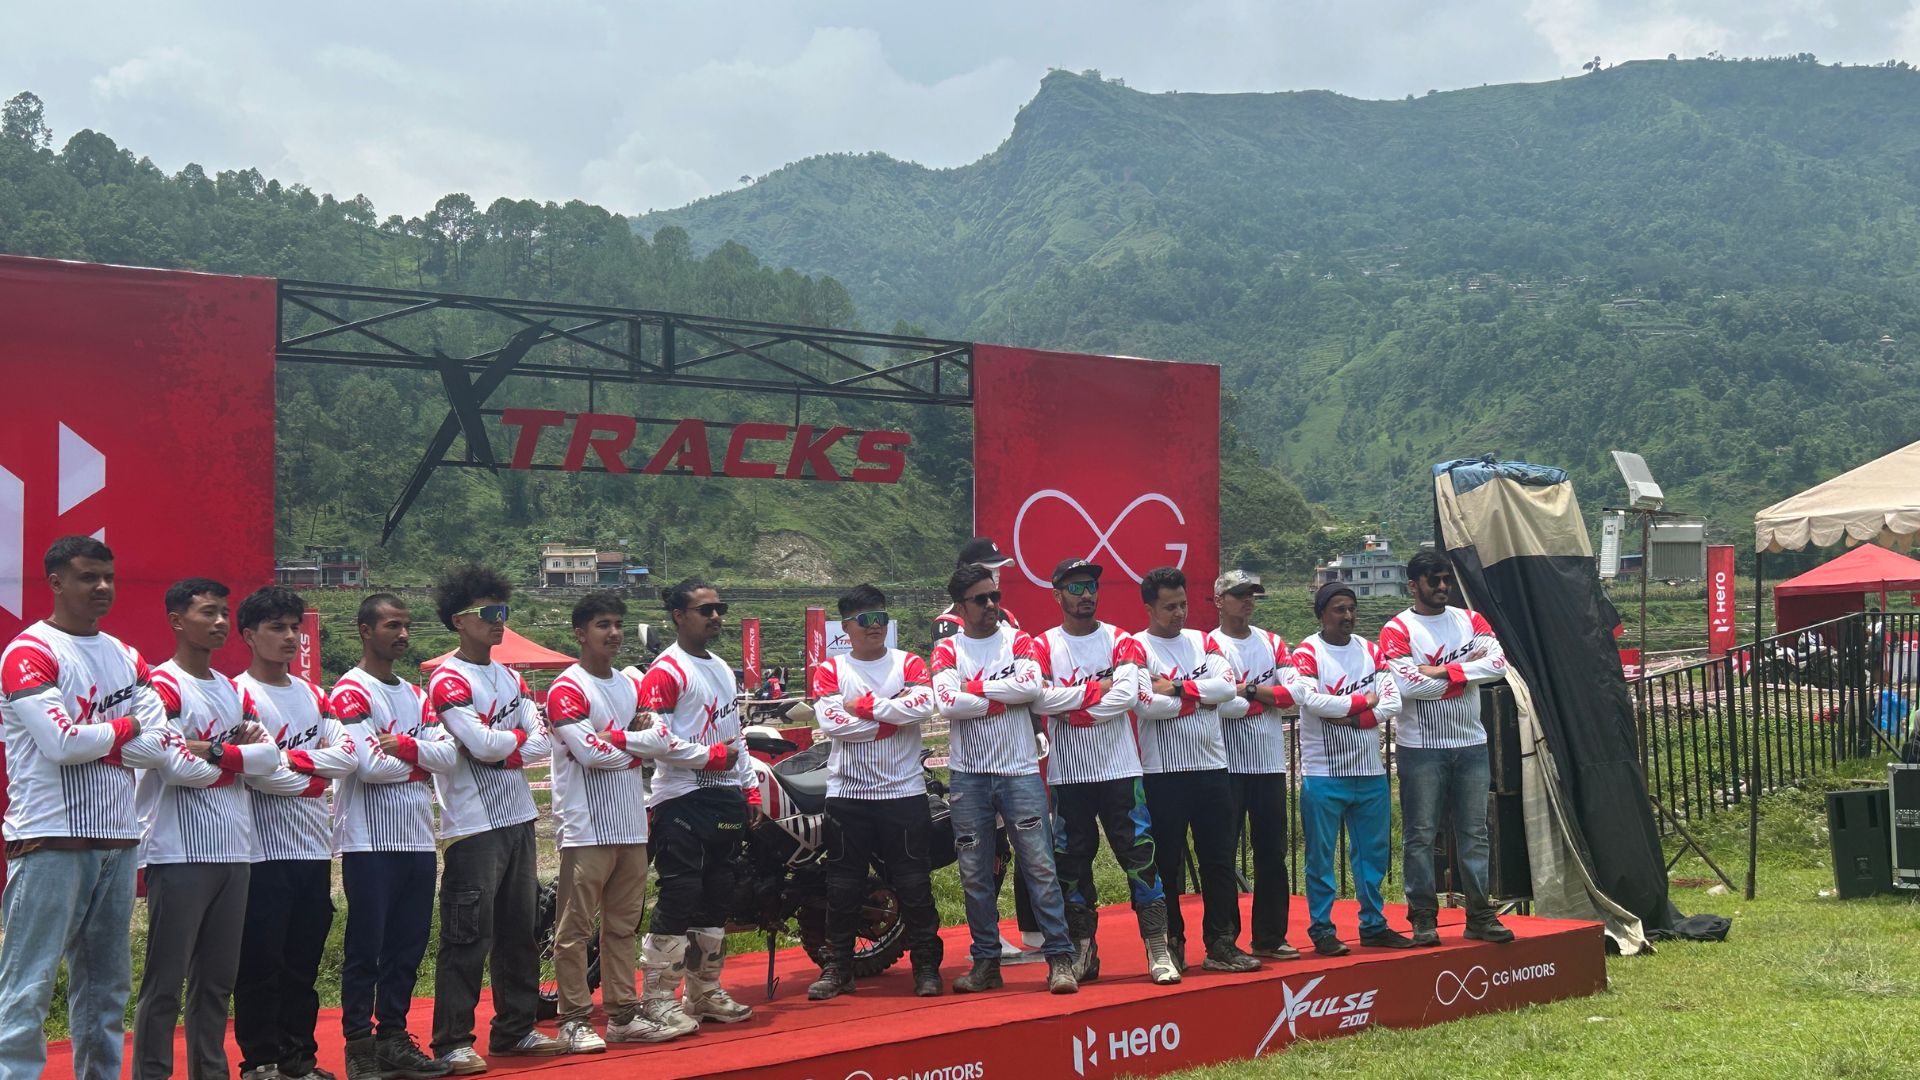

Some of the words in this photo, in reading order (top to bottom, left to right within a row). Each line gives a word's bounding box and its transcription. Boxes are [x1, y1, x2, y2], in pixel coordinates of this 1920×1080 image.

[1715, 571, 1726, 613] Hero
[300, 632, 312, 682] ACKS
[1512, 962, 1556, 983] MOTORS
[1254, 975, 1378, 1058] XPULSE
[1339, 1012, 1369, 1029] 200
[1109, 1022, 1180, 1060] Hero
